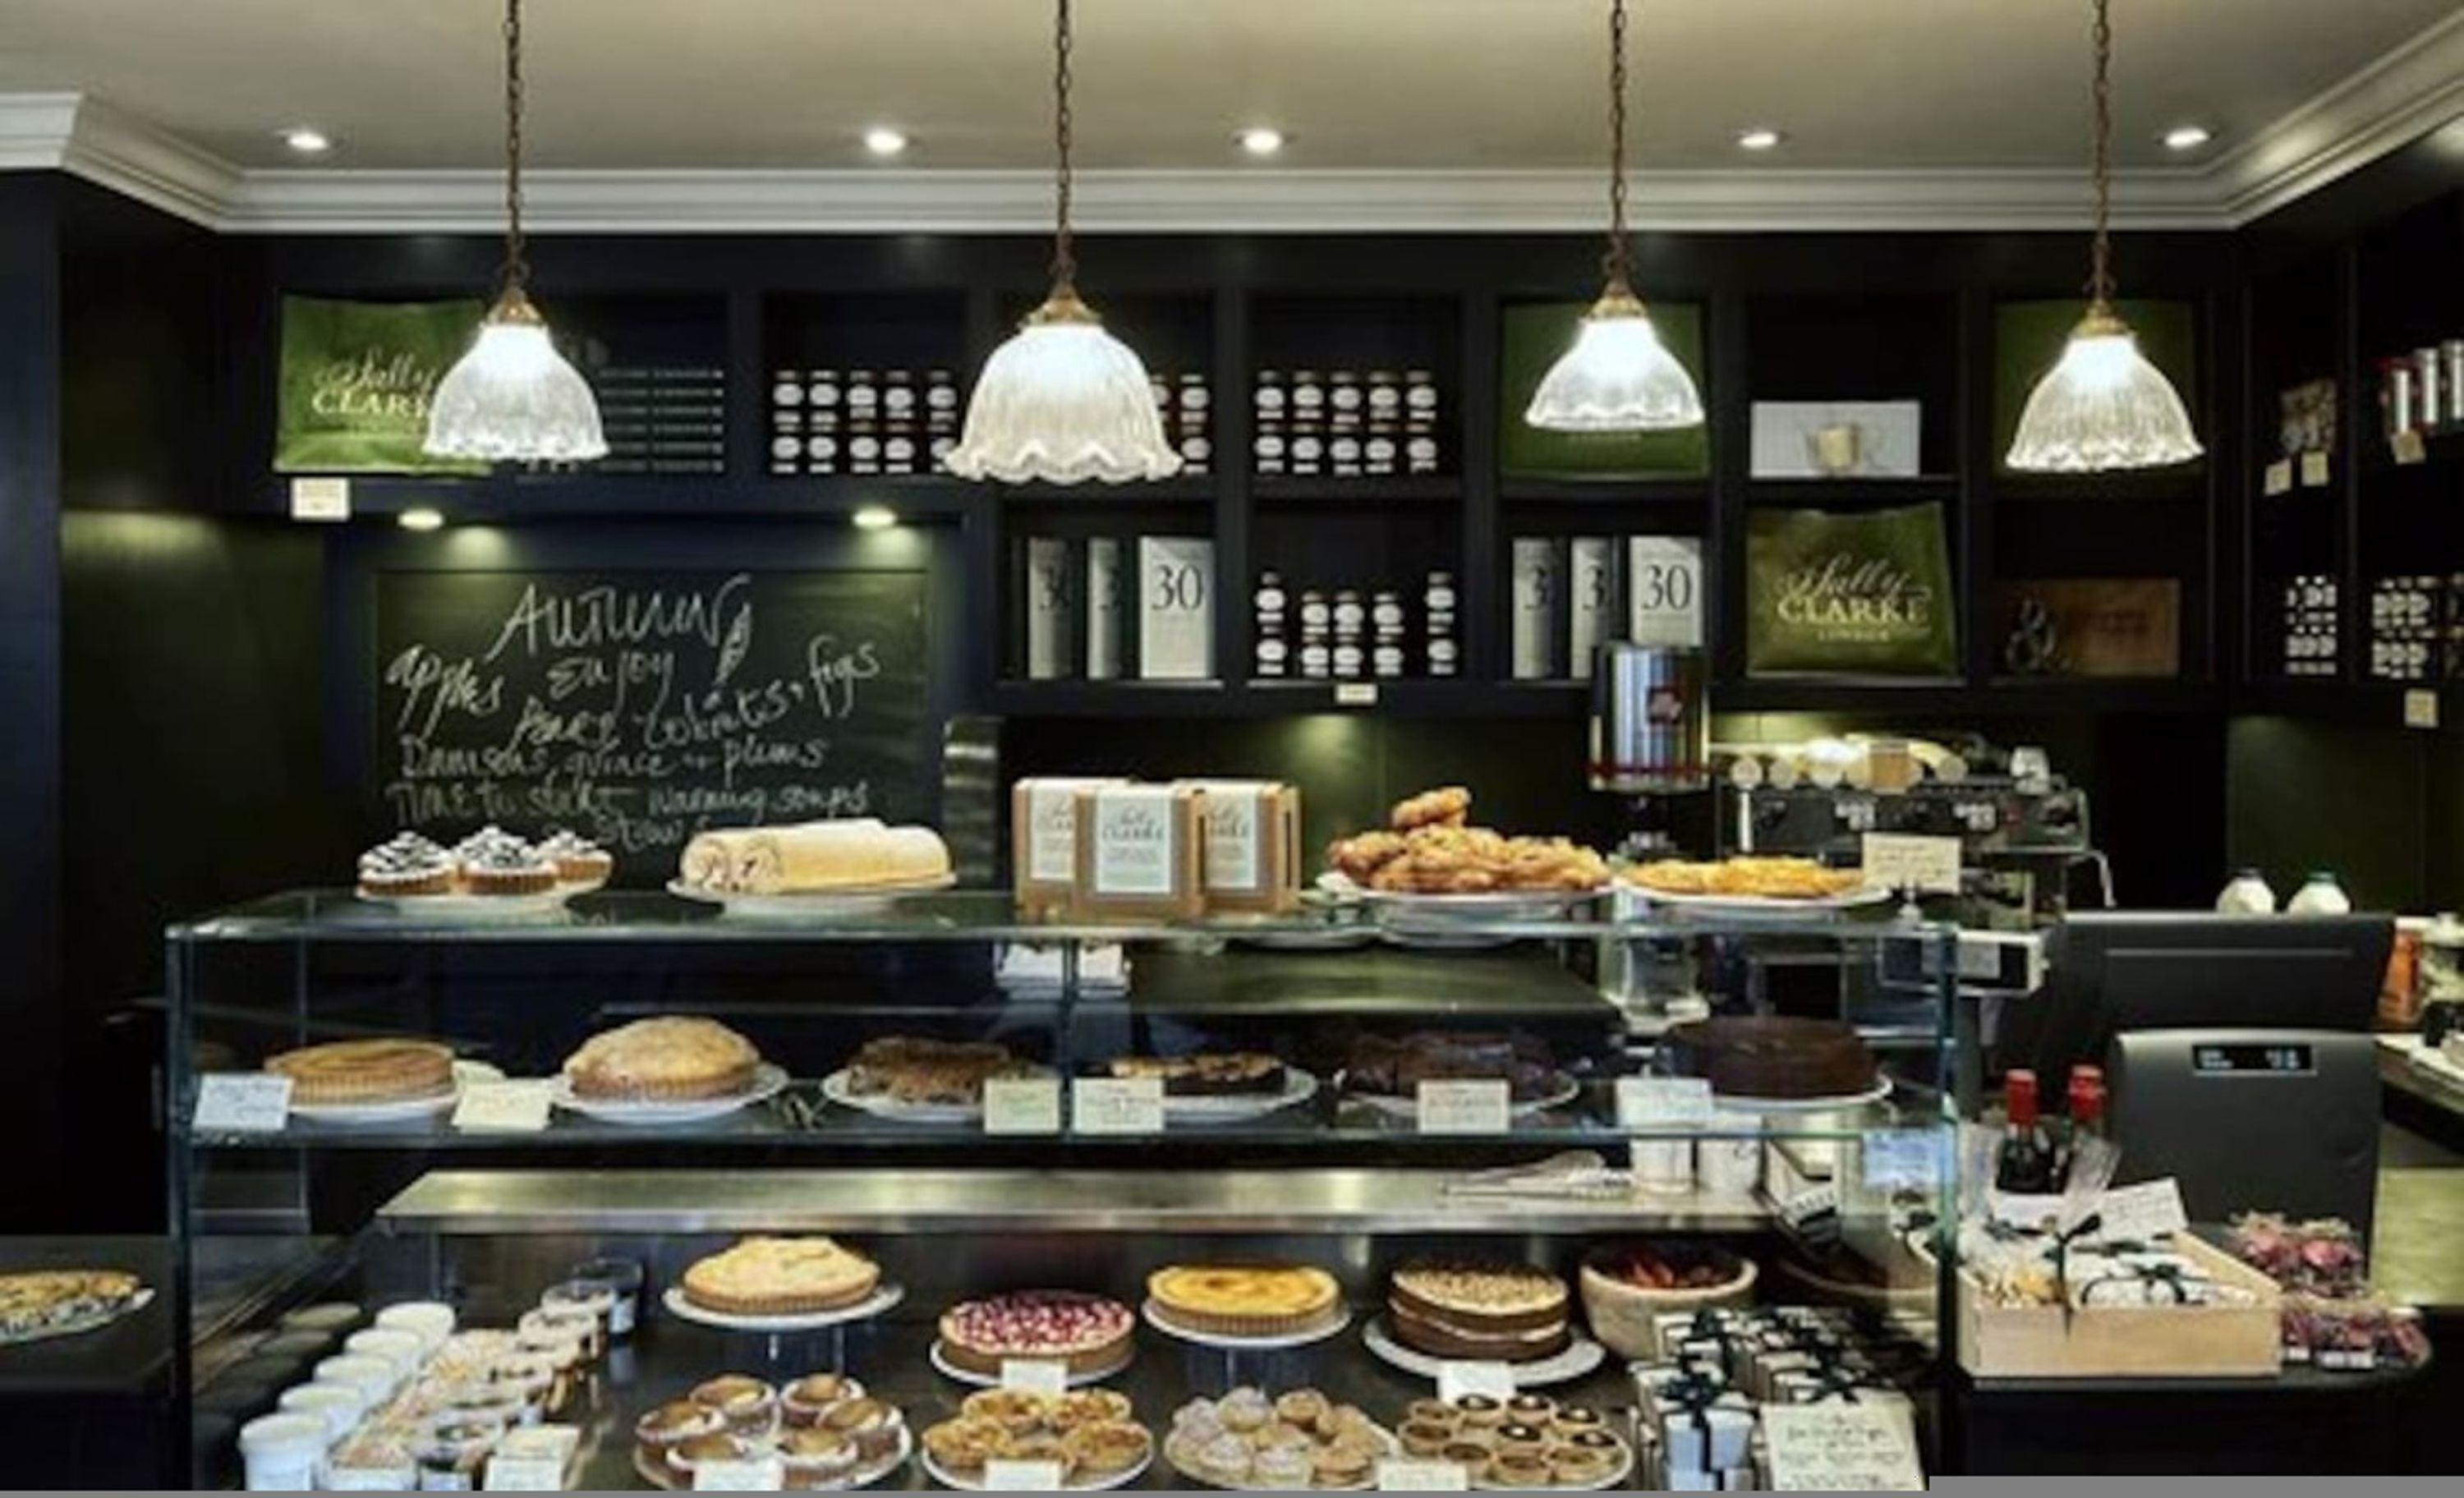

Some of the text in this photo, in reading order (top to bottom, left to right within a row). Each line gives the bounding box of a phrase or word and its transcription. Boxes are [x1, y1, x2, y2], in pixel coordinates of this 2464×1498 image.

[1151, 563, 1205, 611] 30
[1641, 563, 1692, 611] 30
[1777, 595, 1927, 624] CLARKE
